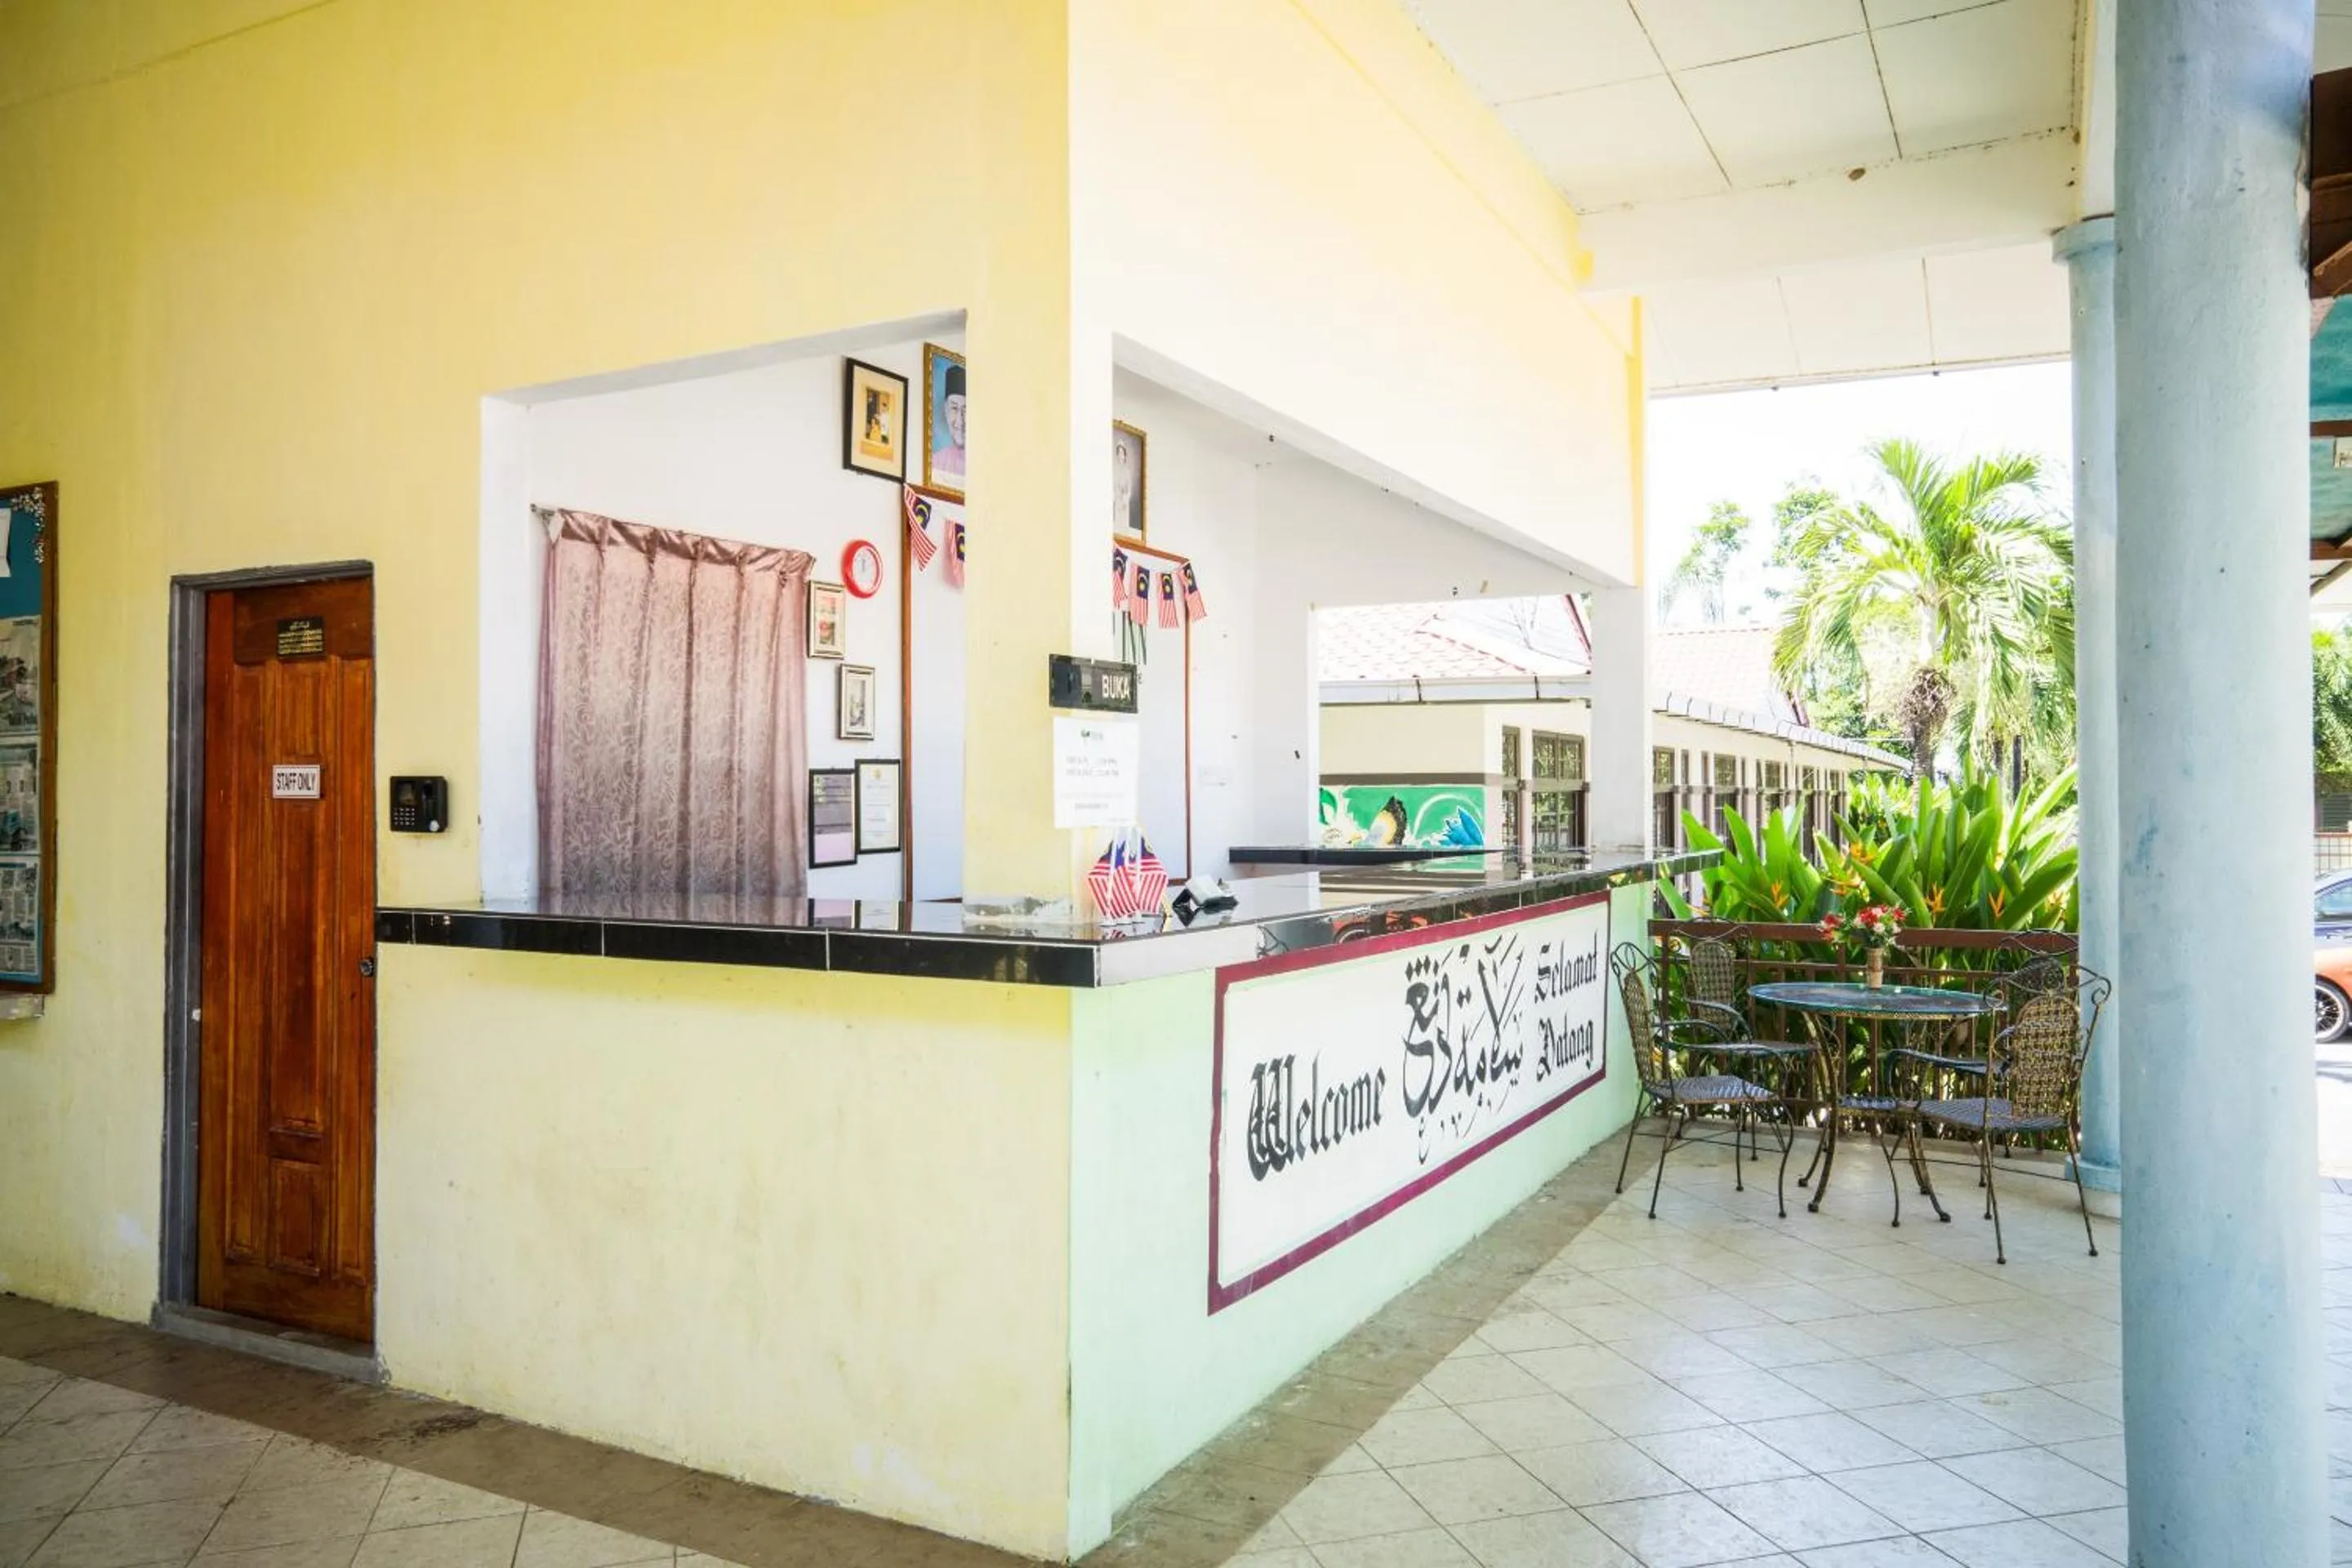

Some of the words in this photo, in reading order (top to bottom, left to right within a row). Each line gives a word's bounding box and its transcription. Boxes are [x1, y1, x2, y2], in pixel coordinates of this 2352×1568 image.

[1102, 675, 1131, 700] BUKA
[277, 773, 296, 791] STAFF
[297, 772, 316, 791] ONLY
[1535, 929, 1598, 1004] Selamat
[1536, 1010, 1594, 1083] Datang
[1247, 1049, 1387, 1182] Welcome
